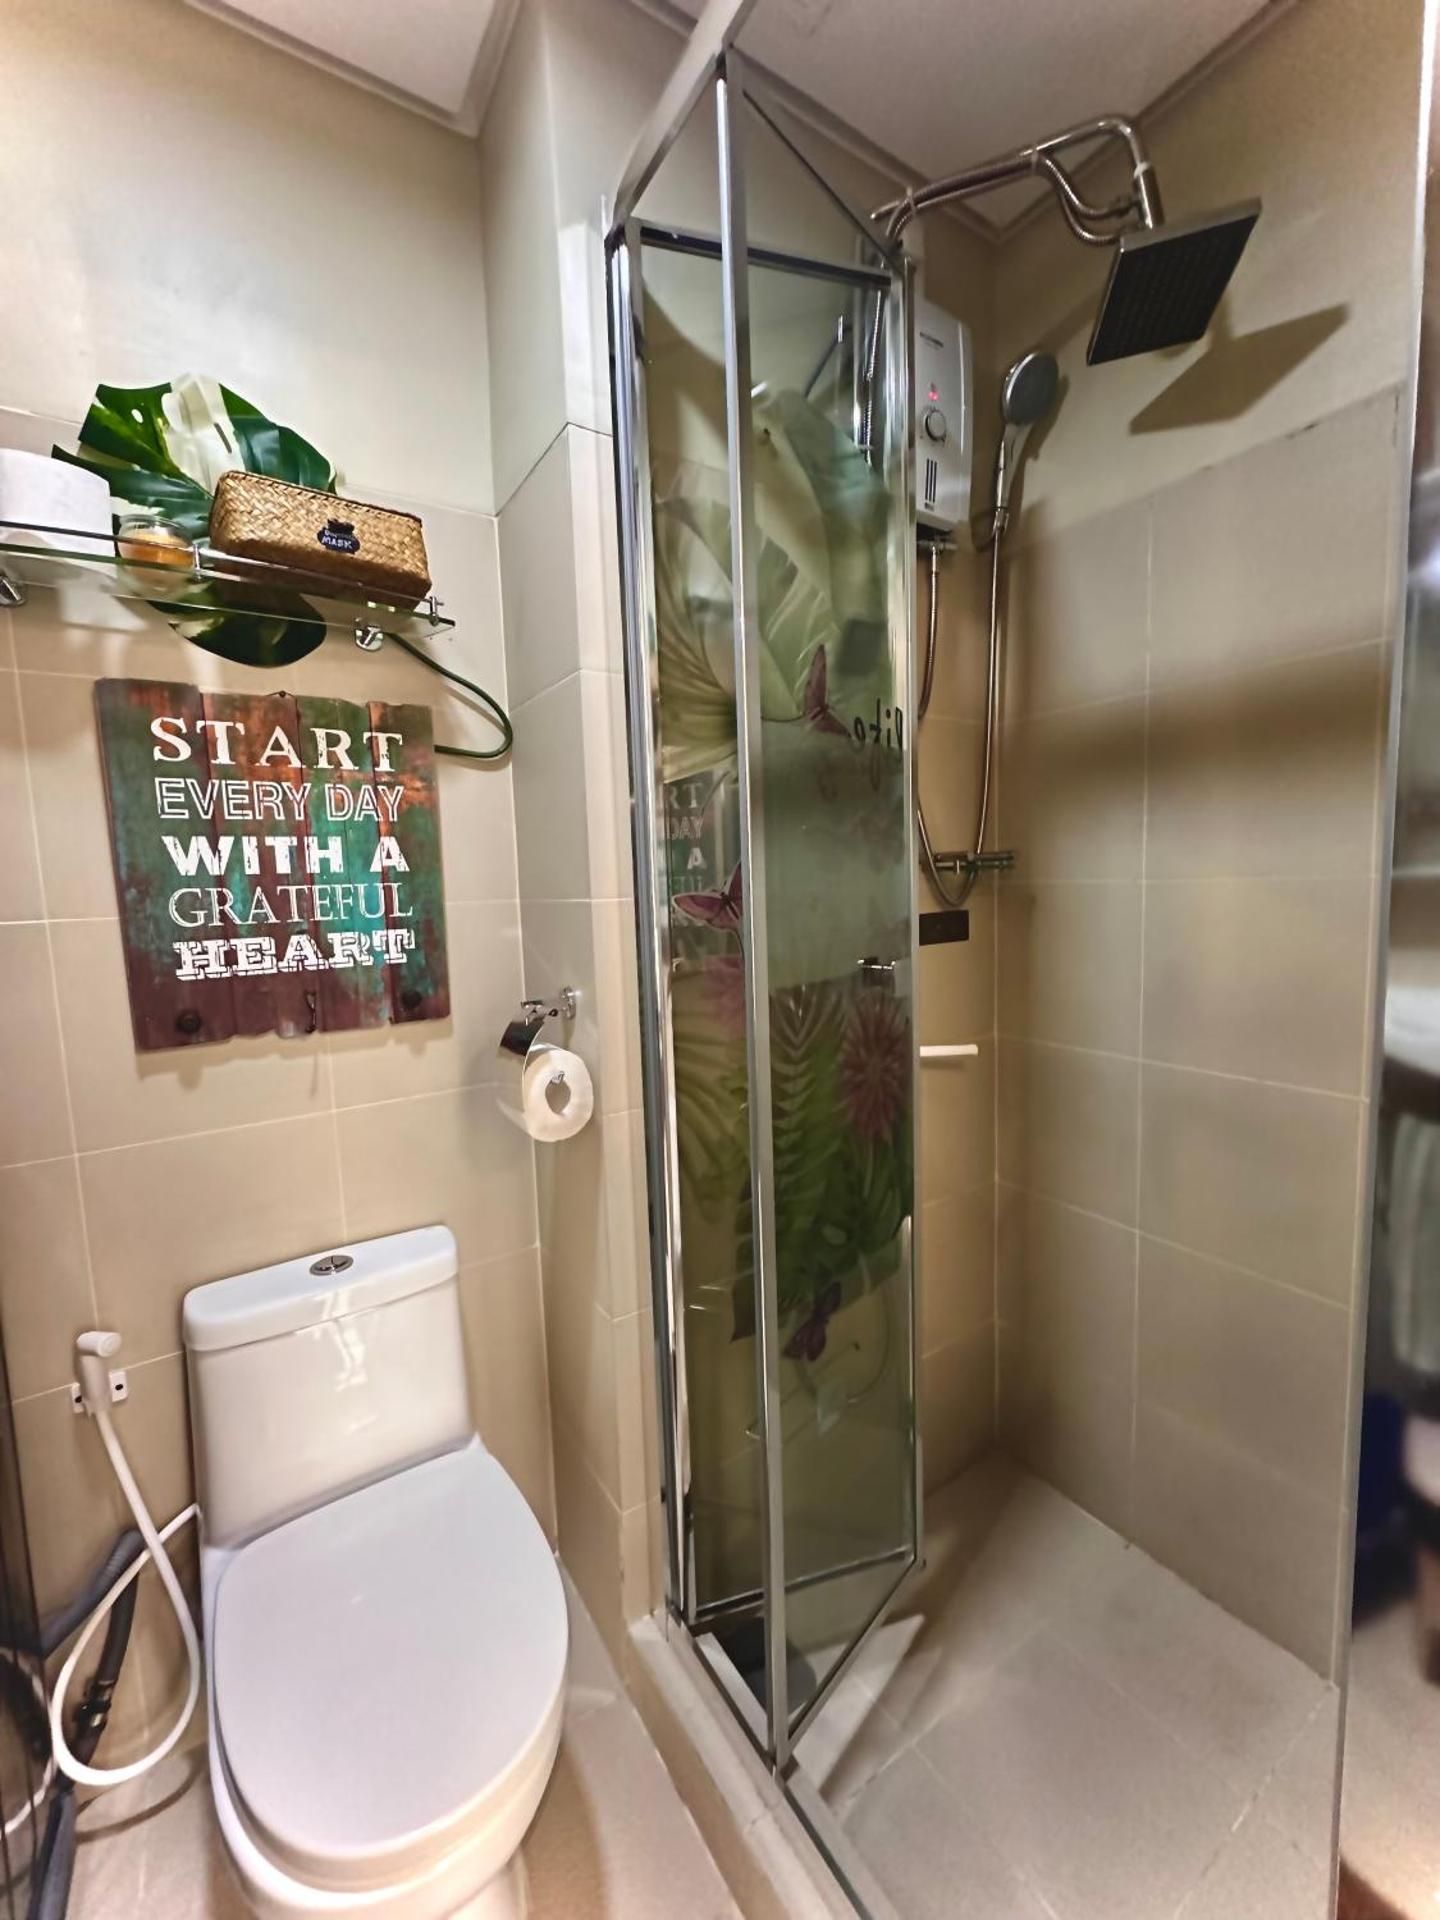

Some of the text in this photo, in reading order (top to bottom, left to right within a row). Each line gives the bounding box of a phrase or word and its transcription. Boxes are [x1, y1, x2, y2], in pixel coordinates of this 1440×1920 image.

[322, 536, 352, 549] MASK
[150, 717, 402, 772] START
[155, 777, 404, 821] EVERY DAY
[161, 835, 410, 876] WITH A
[168, 882, 413, 928] GRATEFUL
[173, 928, 416, 980] HEART
